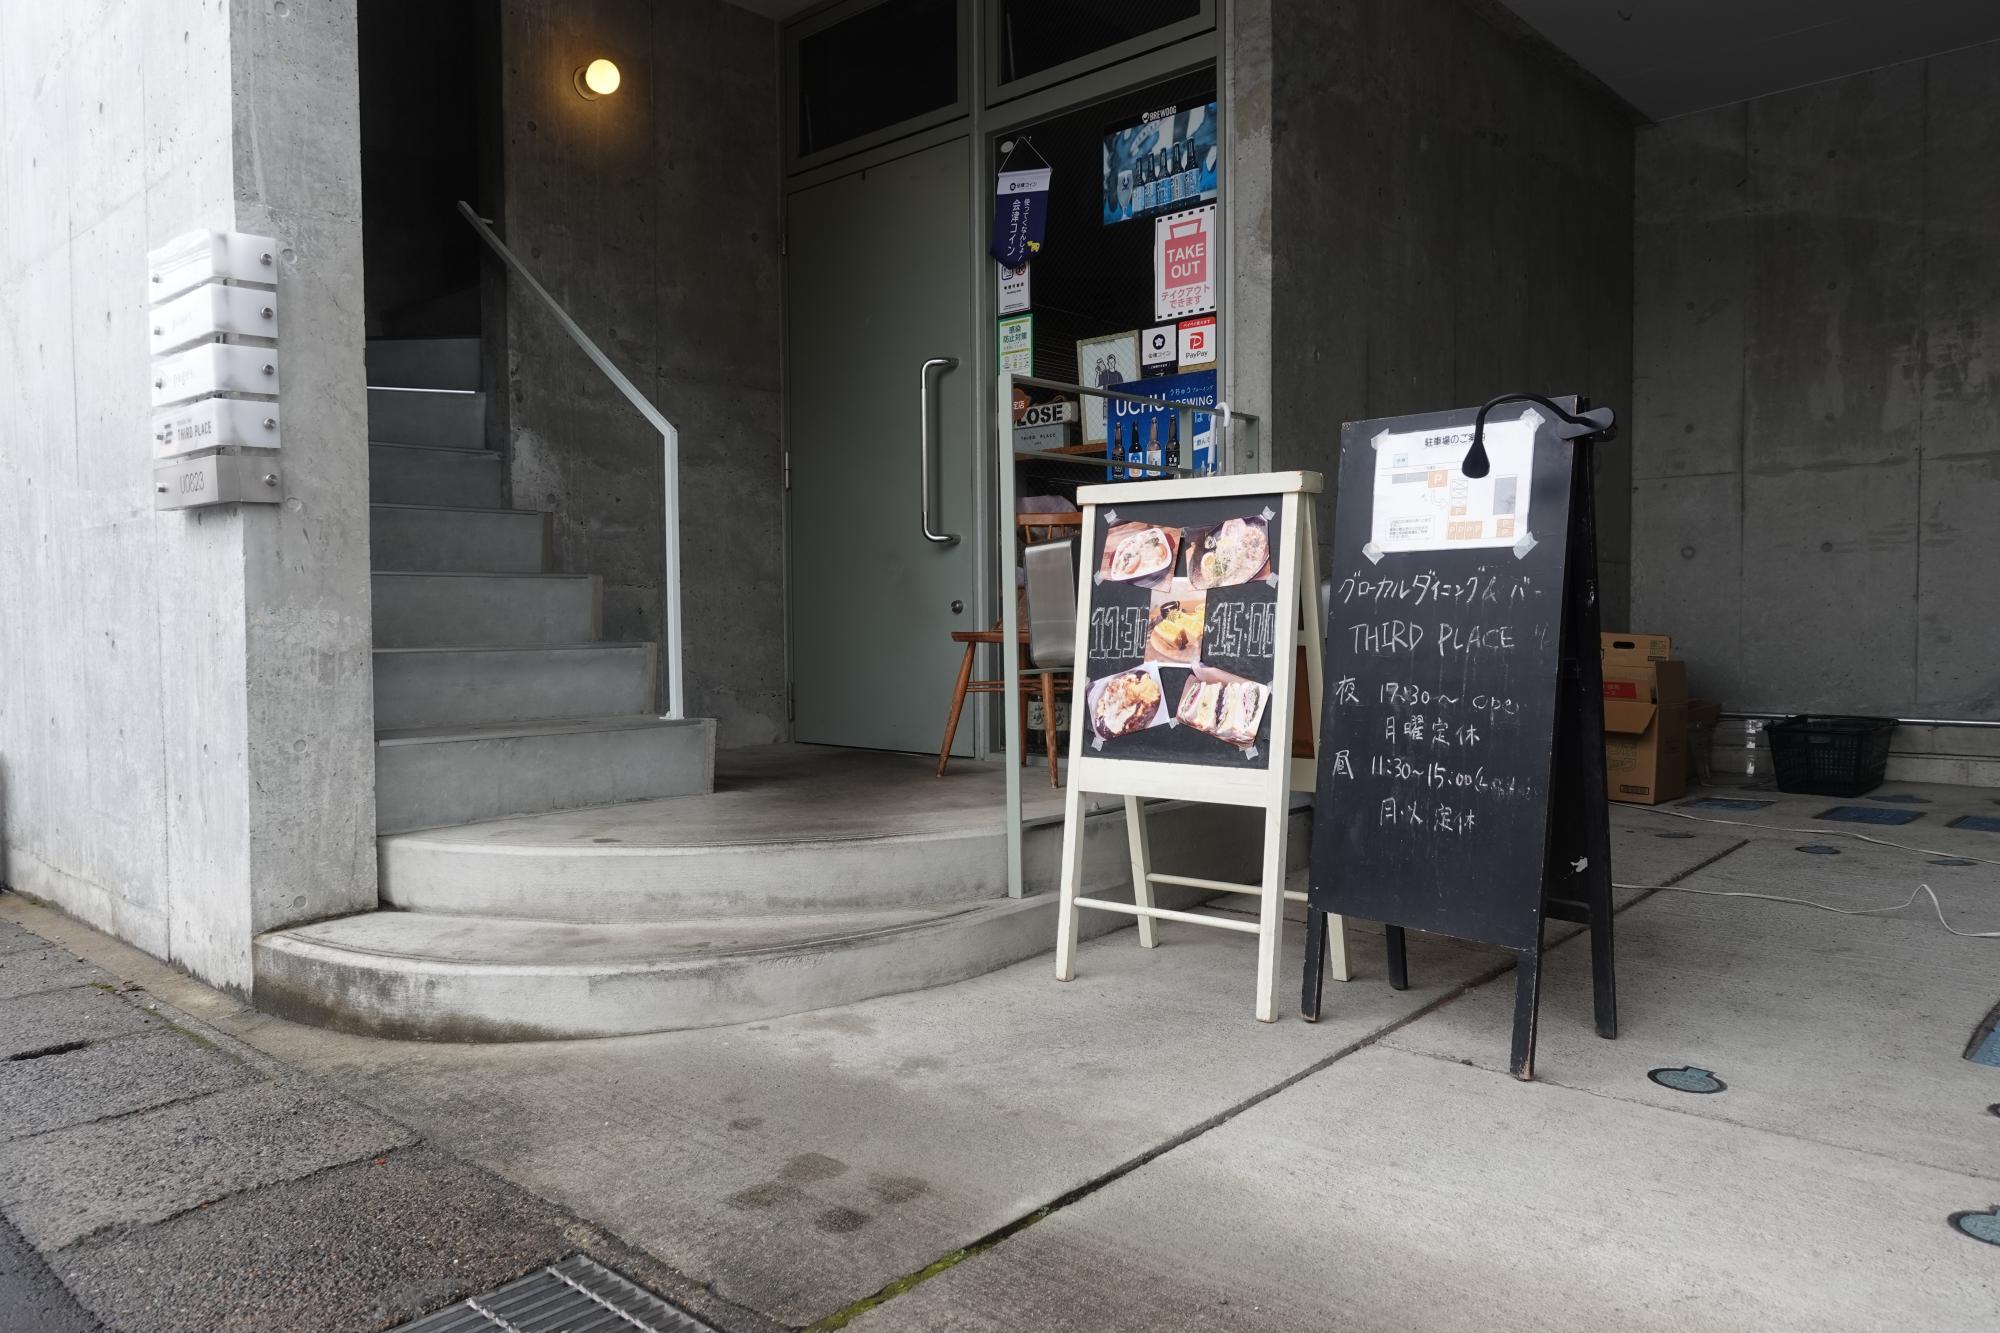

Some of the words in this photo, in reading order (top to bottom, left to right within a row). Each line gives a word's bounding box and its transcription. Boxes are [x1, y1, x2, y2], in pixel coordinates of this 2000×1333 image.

[1149, 105, 1177, 121] BREWDOG
[1007, 199, 1021, 257] 会津コイン
[1166, 242, 1205, 263] TAKE
[1171, 260, 1201, 279] OUT
[1161, 284, 1210, 301] テイクアウト
[1169, 295, 1202, 309] できます
[1185, 350, 1208, 359] PayPay
[1170, 394, 1214, 411] EWING
[1014, 404, 1063, 431] LOSE
[177, 426, 194, 441] THIRD
[194, 420, 212, 437] PLACE
[1349, 619, 1424, 654] THIRD
[1438, 622, 1515, 656] PLACE
[1336, 675, 1360, 705] 夜
